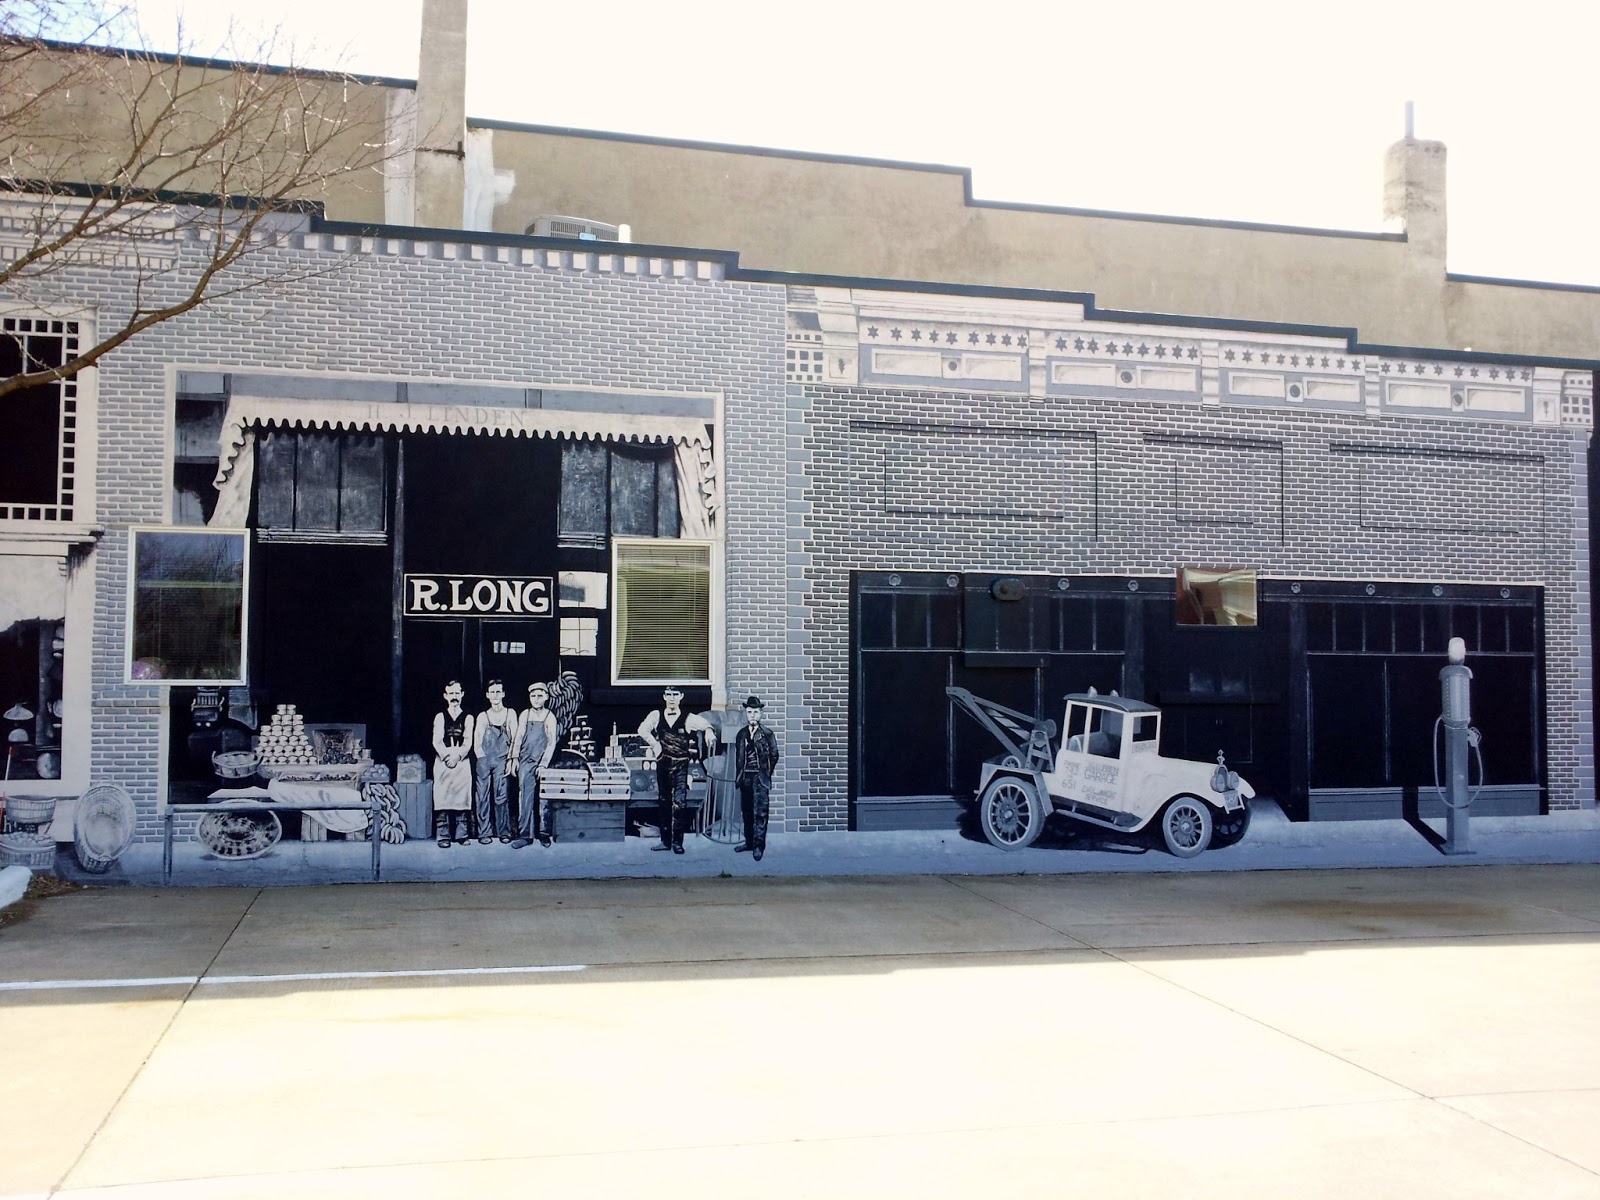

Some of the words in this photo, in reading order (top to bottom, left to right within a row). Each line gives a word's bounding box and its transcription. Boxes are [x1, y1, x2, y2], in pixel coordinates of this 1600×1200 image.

[427, 406, 526, 427] LINDEN
[1062, 779, 1077, 790] 651
[1084, 769, 1118, 786] GARAGE
